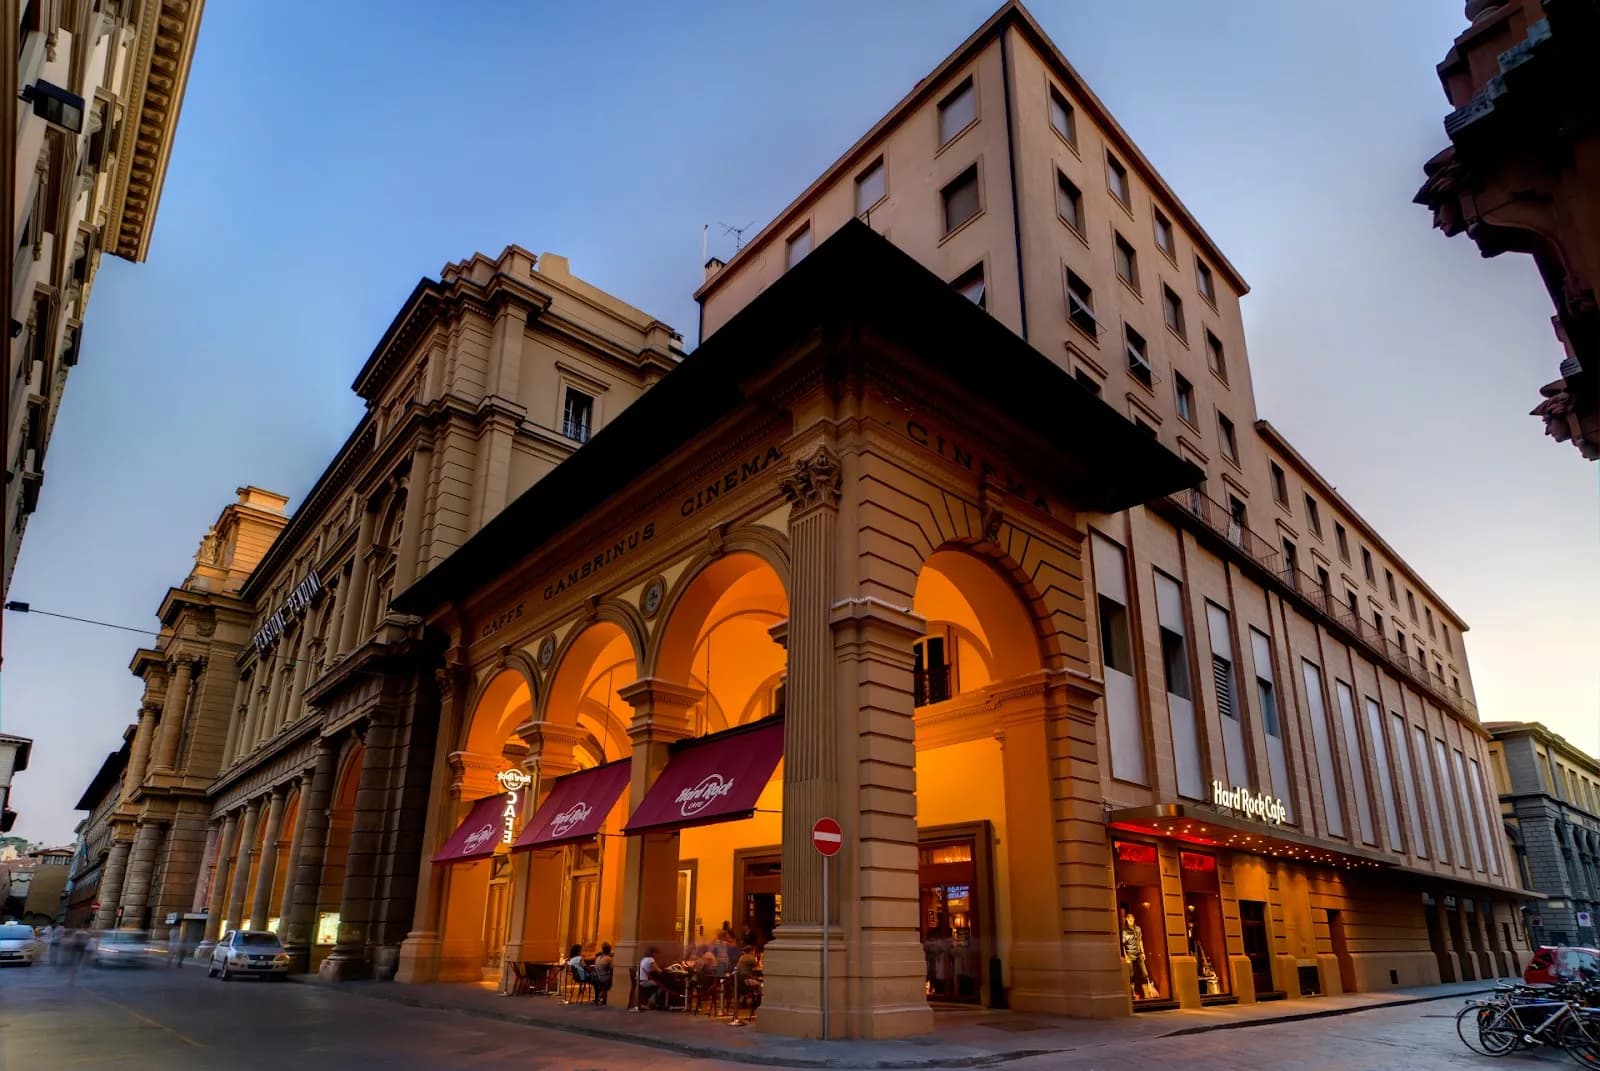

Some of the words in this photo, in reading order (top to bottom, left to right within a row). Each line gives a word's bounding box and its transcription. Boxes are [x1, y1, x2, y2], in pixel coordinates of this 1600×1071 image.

[543, 522, 655, 600] GAMBRINUS
[681, 447, 783, 516] CINEMA
[675, 783, 709, 803] Hard
[702, 778, 734, 800] Rock
[1212, 780, 1241, 810] Hard
[1241, 788, 1266, 822] Rock
[1265, 795, 1286, 825] Cafe
